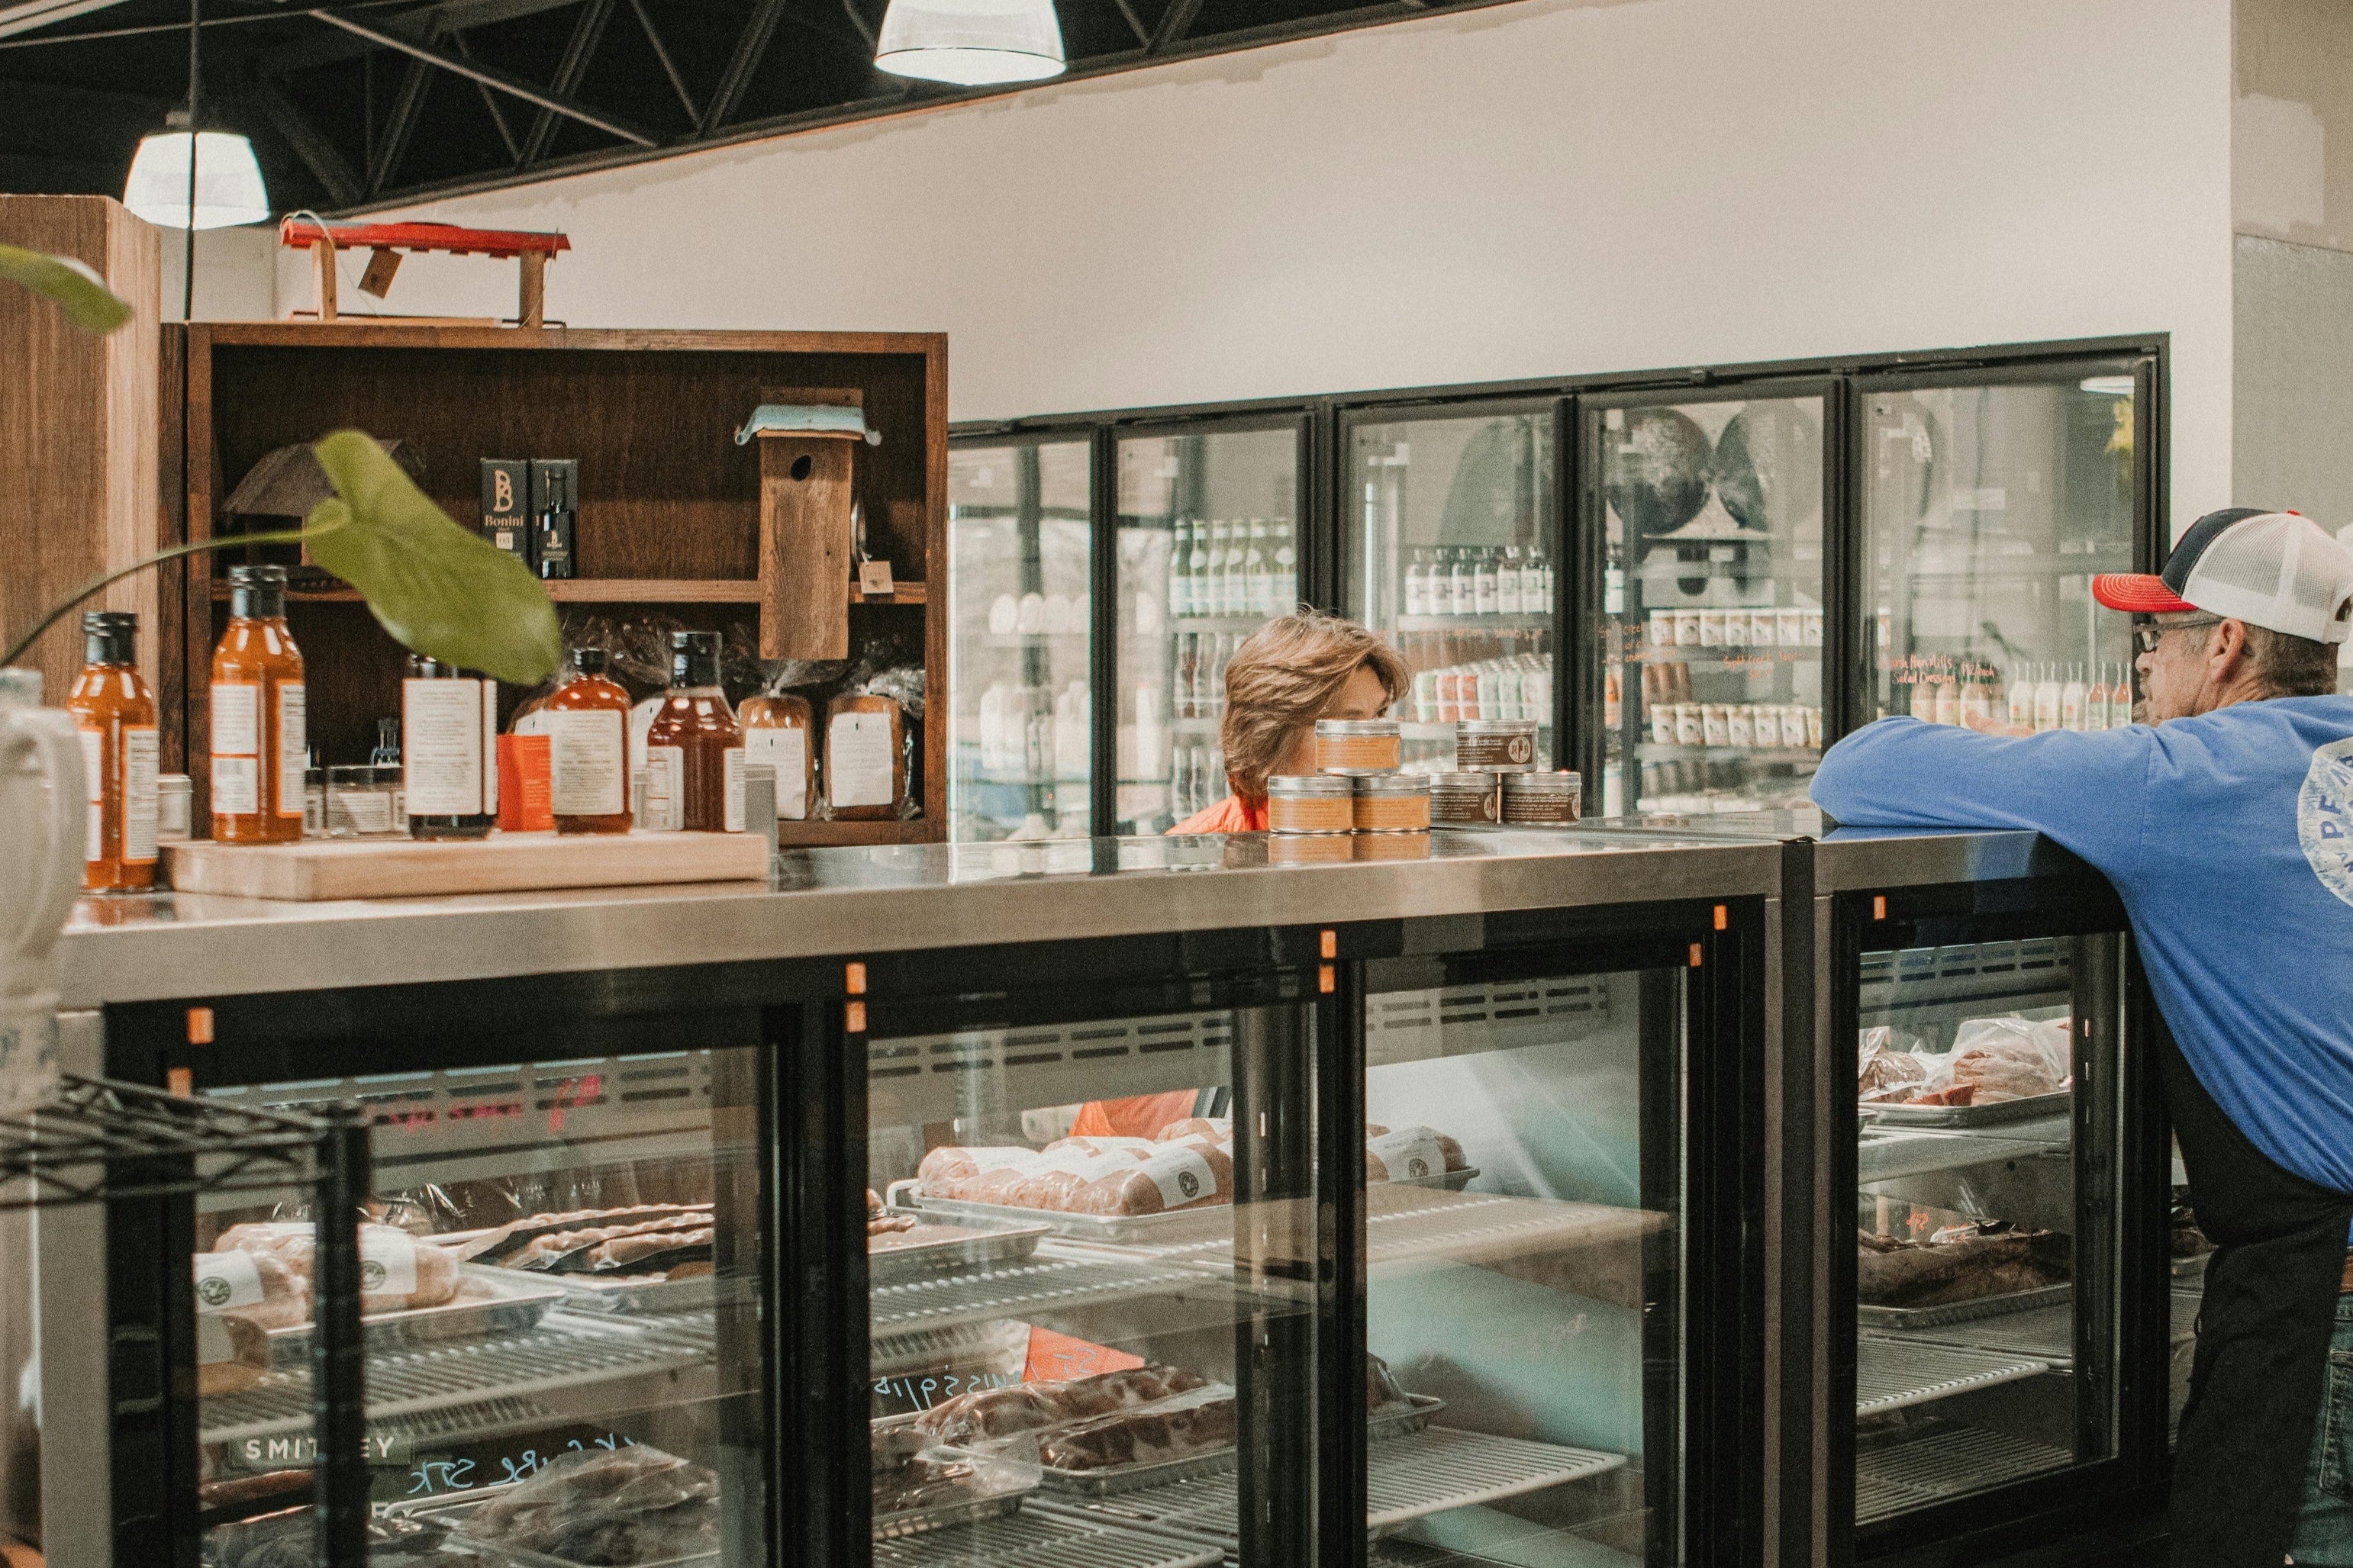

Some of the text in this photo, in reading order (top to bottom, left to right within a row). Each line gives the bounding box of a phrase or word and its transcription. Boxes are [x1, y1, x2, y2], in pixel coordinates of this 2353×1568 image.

[484, 514, 524, 527] Bonini
[1893, 671, 1917, 684] Salad
[245, 1437, 395, 1460] SMITEY
